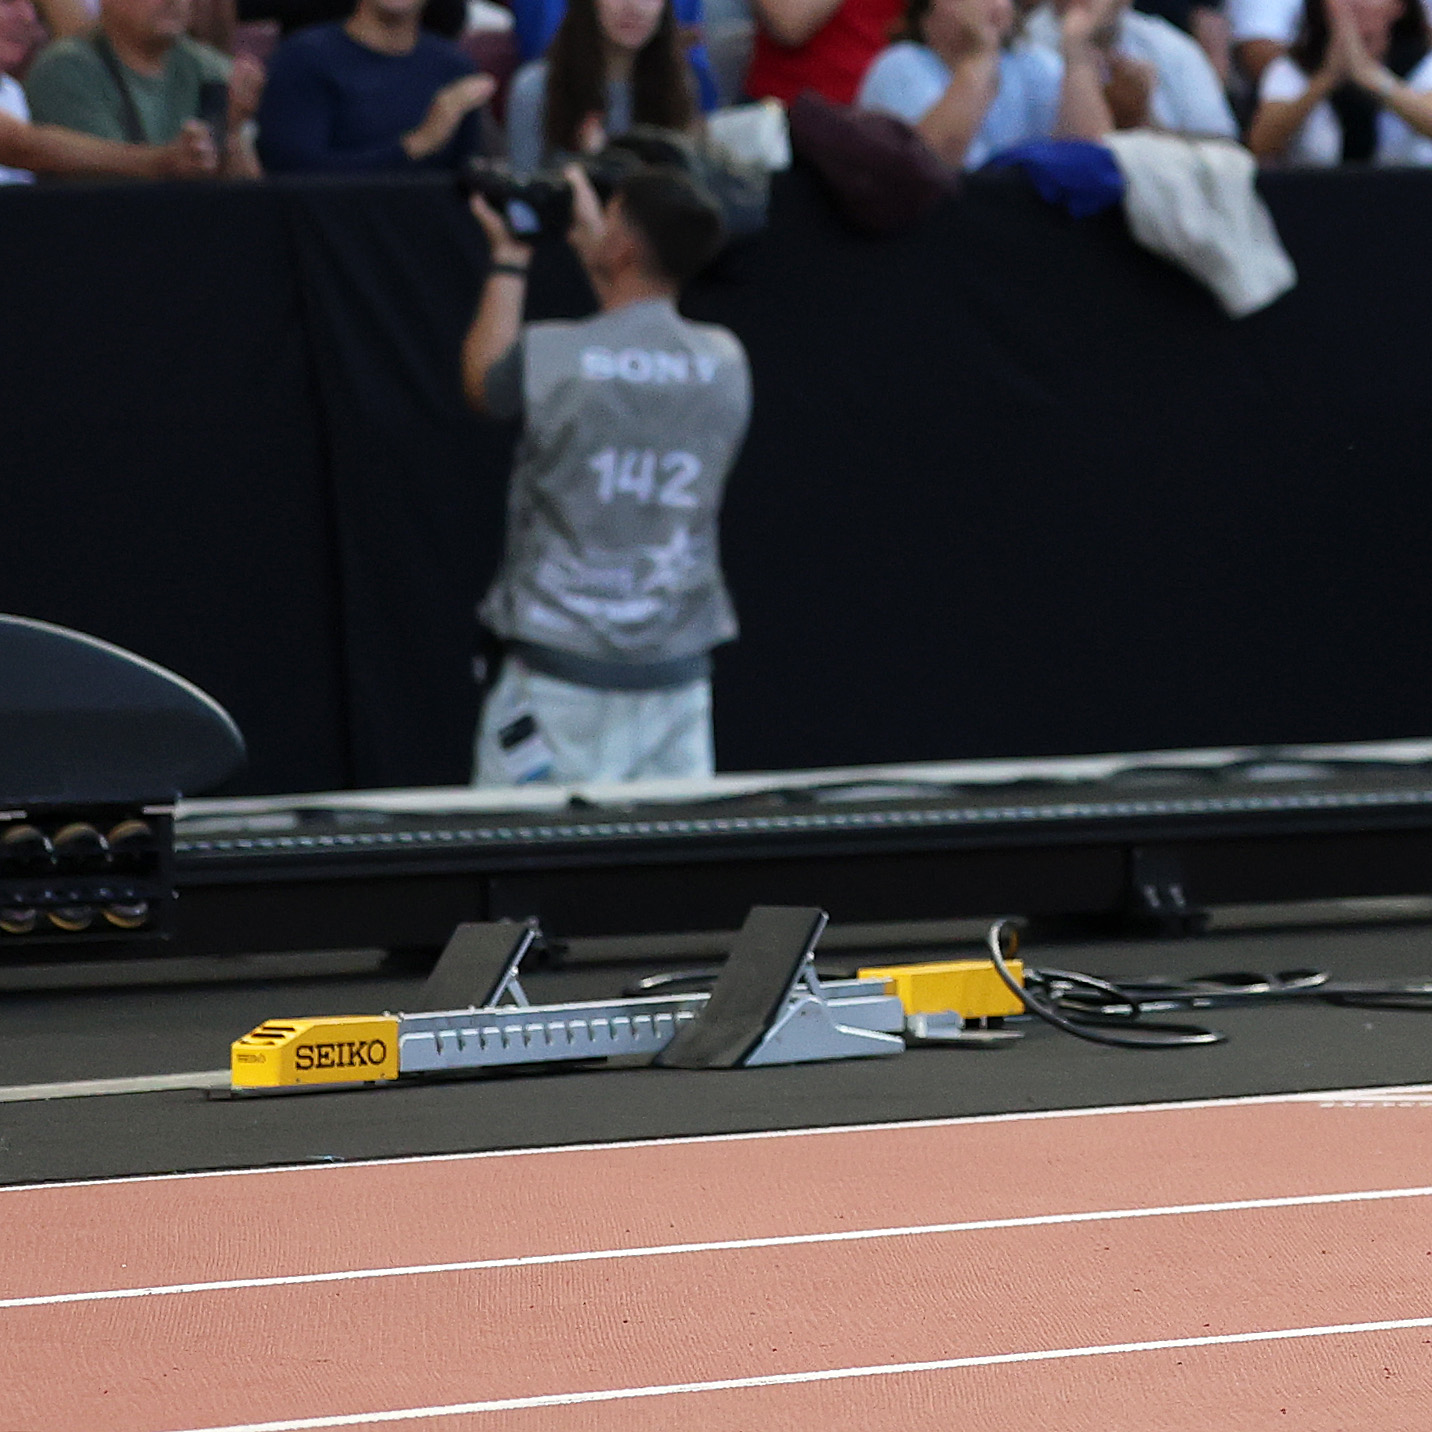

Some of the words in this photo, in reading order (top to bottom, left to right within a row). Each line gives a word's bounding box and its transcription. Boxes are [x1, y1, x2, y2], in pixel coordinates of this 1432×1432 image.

[578, 346, 719, 385] SONY
[588, 446, 703, 508] 142
[295, 1039, 387, 1070] SEIKO
